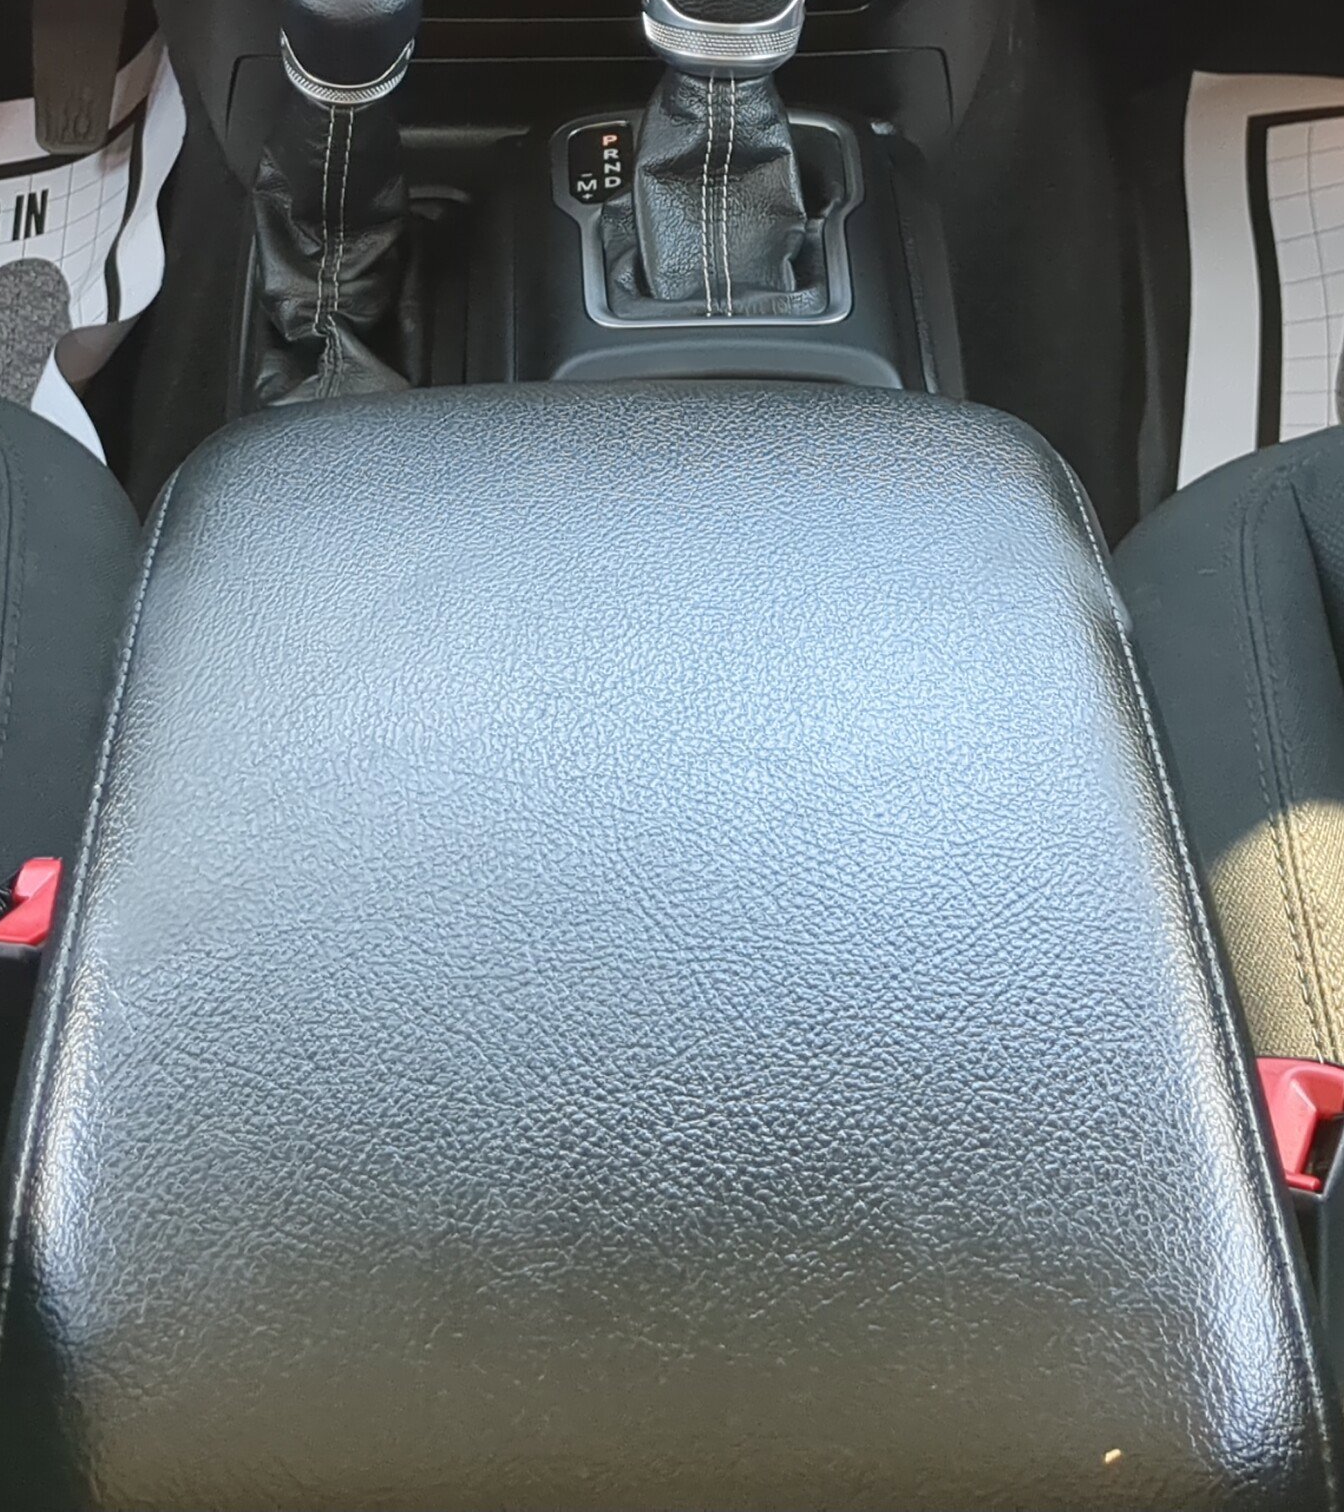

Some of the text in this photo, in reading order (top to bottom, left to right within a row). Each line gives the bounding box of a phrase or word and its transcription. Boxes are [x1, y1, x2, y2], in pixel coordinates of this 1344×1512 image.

[602, 134, 618, 147] P
[603, 148, 619, 161] R
[604, 161, 621, 174] N
[577, 179, 598, 192] M
[604, 176, 621, 188] D
[12, 189, 49, 242] IN
